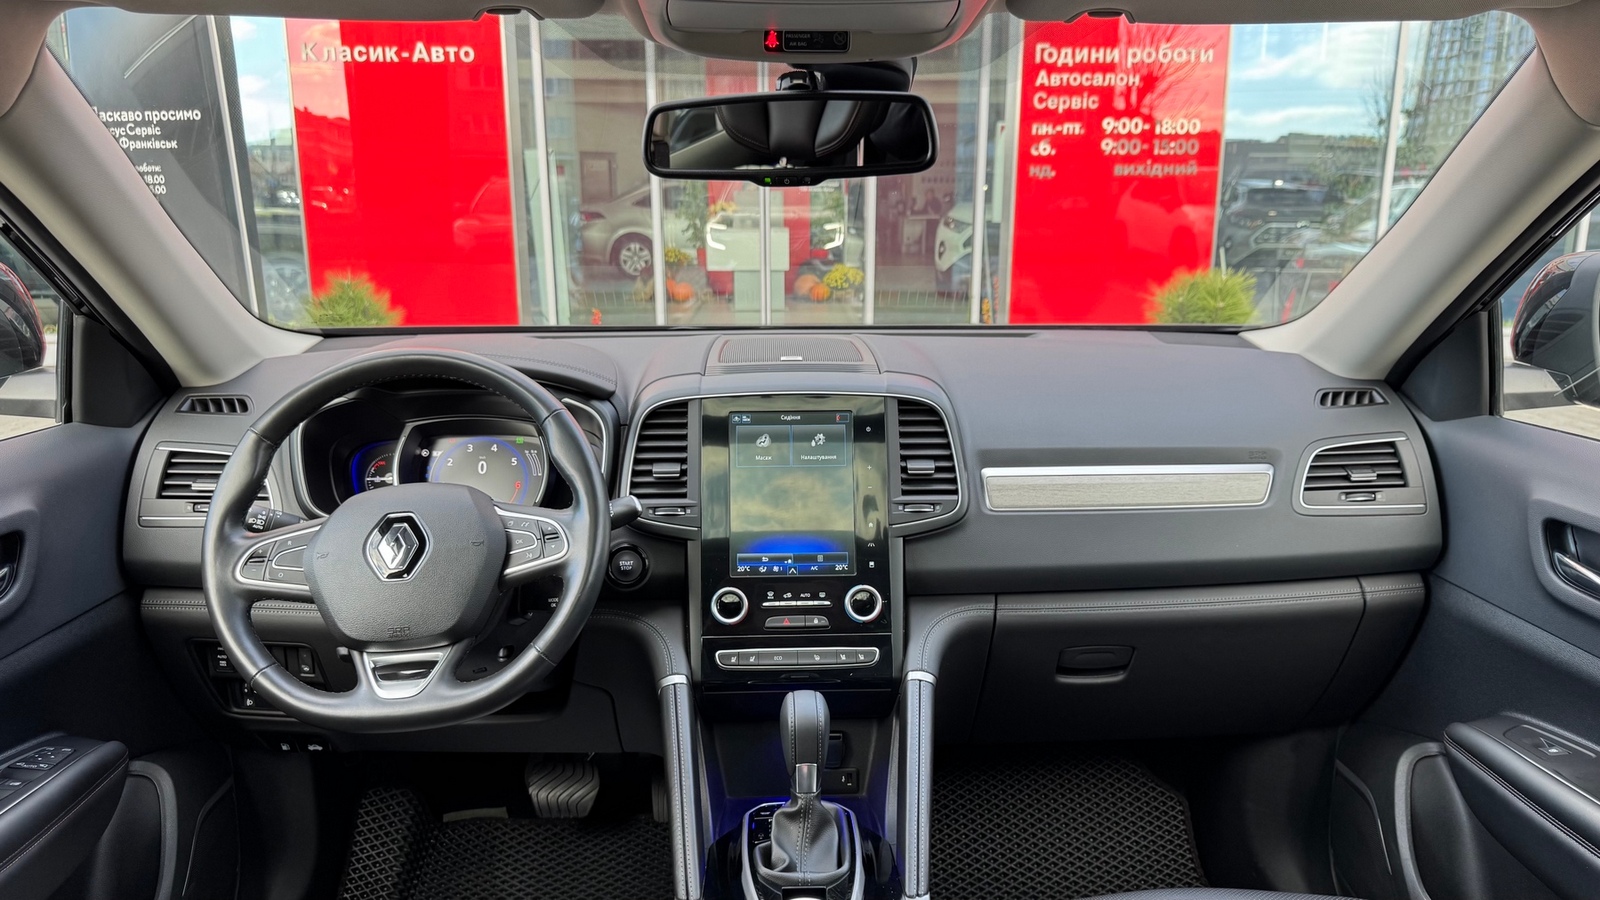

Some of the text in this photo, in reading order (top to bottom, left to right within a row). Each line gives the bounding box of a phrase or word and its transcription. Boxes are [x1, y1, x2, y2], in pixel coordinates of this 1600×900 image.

[301, 41, 475, 62] Класик-Авто
[1034, 43, 1214, 68] Години роботи
[1035, 70, 1140, 87] Автосалон
[1033, 92, 1099, 113] Сервіс
[144, 109, 201, 124] просимо
[119, 137, 178, 151] Франківськ
[1114, 159, 1198, 177] вихідний
[466, 444, 474, 453] 3
[490, 444, 498, 452] 4
[446, 458, 453, 466] 2
[477, 460, 487, 475] 0
[511, 457, 518, 466] 5
[514, 481, 521, 489] 6
